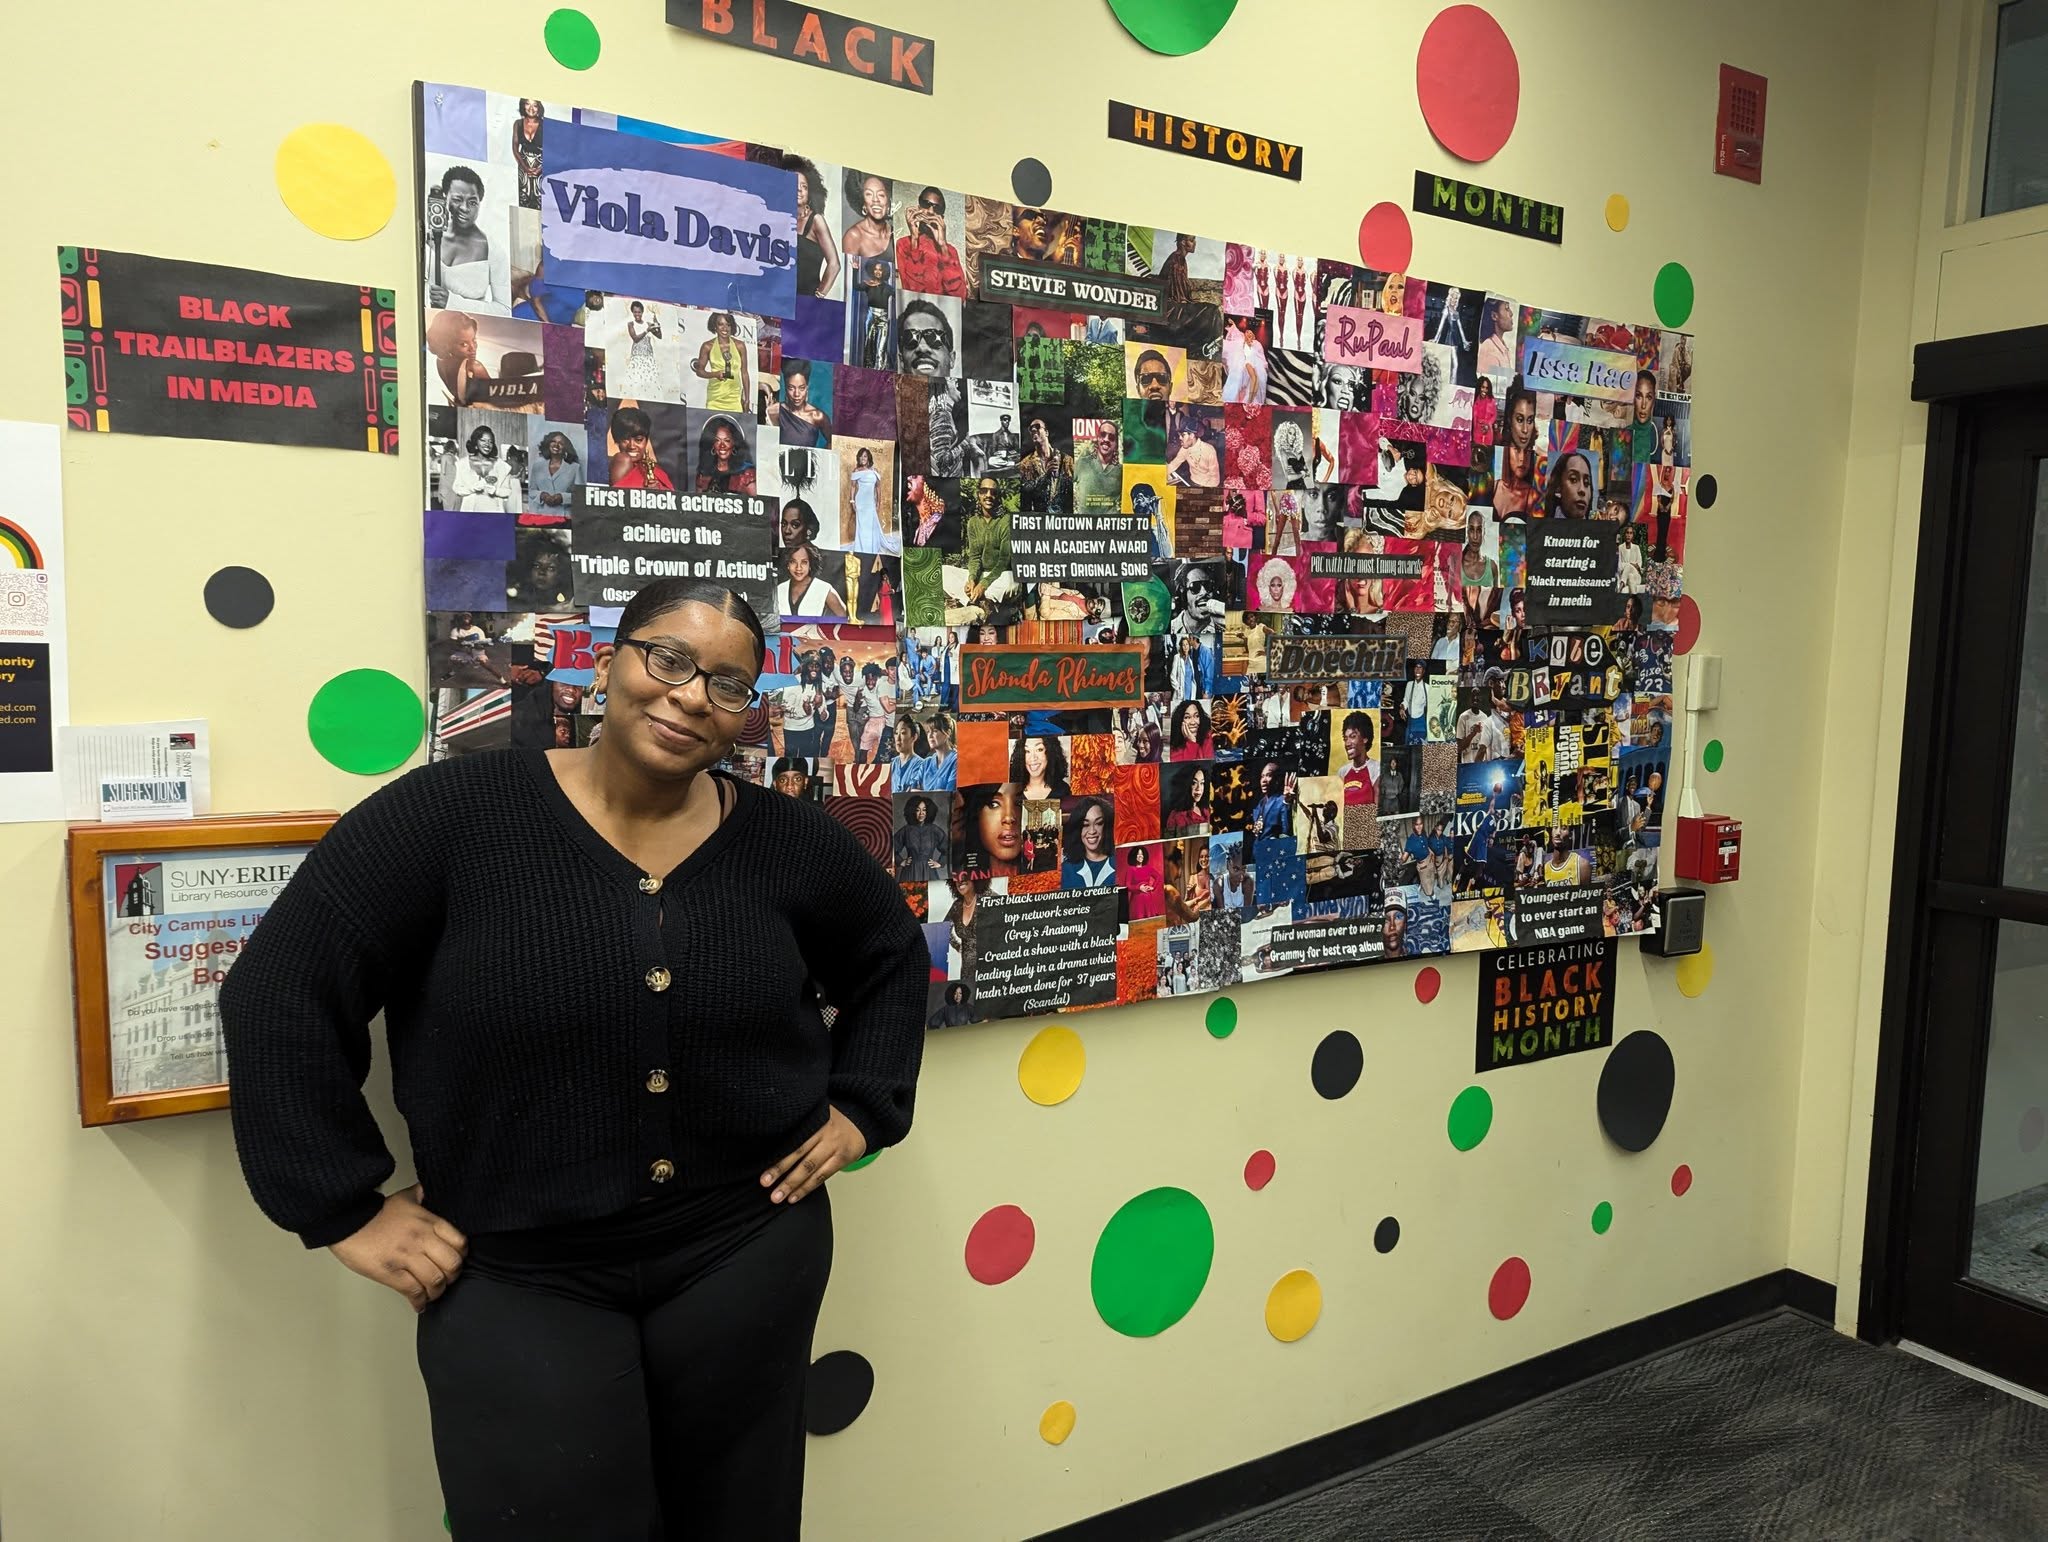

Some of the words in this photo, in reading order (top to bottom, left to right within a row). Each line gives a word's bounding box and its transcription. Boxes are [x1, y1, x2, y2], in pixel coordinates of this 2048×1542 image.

[702, 0, 924, 87] BLACK
[1134, 108, 1297, 173] HISTORY
[1719, 134, 1727, 166] FIRE
[1432, 175, 1559, 236] MONTH
[546, 177, 669, 243] Viola
[674, 206, 791, 267] Davis
[990, 269, 1066, 296] STEVIE
[1072, 282, 1158, 311] WONDER
[178, 296, 292, 328] BLACK
[1334, 314, 1414, 362] RuPaul
[114, 331, 356, 373] TRAILBLAZERS
[1526, 351, 1583, 383] Issa
[1586, 360, 1633, 390] Rae
[167, 376, 204, 400] IN
[210, 379, 317, 409] MEDIA
[489, 382, 538, 398] VIOLA
[585, 486, 625, 508] First
[629, 489, 677, 511] Black
[681, 494, 743, 515] actress
[748, 498, 765, 516] to
[622, 523, 690, 544] achieve
[695, 526, 722, 546] the
[1544, 535, 1581, 548] Known
[1583, 536, 1600, 549] for
[571, 553, 630, 577] "Triple
[634, 558, 689, 577] Crown
[694, 559, 711, 578] of
[1311, 555, 1325, 573] POC
[1325, 556, 1342, 573] with
[1343, 556, 1356, 574] the
[1357, 558, 1375, 574] most
[1376, 557, 1397, 576] Emmy
[1545, 557, 1590, 571] starting
[1590, 560, 1596, 569] a
[1548, 595, 1559, 606] in
[1560, 594, 1592, 606] media
[1279, 640, 1398, 675] Doechii
[967, 656, 1053, 698] Shonda
[1056, 656, 1139, 699] Rhimes
[1556, 726, 1571, 777] Bryant
[1569, 732, 1581, 769] Kobe
[109, 781, 180, 802] SUGGESTIONS
[171, 891, 211, 902] Library
[214, 887, 268, 899] Resource
[1006, 893, 1033, 905] black
[1034, 892, 1070, 902] woman
[1071, 889, 1082, 899] to
[1084, 886, 1112, 897] create
[1519, 890, 1569, 904] Youngest
[1570, 887, 1603, 901] player
[129, 922, 161, 936] City
[168, 917, 236, 932] Campus
[1004, 913, 1020, 926] top
[1021, 905, 1062, 921] network
[1063, 905, 1091, 916] series
[1521, 912, 1533, 923] to
[1534, 909, 1557, 921] ever
[1558, 907, 1583, 918] start
[1585, 905, 1598, 915] an
[1041, 920, 1088, 937] Anatomy)
[1273, 928, 1295, 942] Third
[1296, 928, 1326, 940] woman
[1328, 926, 1348, 937] ever
[1349, 925, 1358, 935] to
[1359, 923, 1375, 934] win
[1376, 924, 1383, 933] a
[1534, 928, 1556, 939] NBA
[1558, 924, 1585, 939] game
[145, 936, 248, 962] Suggest
[1023, 949, 1030, 957] a
[1031, 943, 1059, 957] show
[1060, 939, 1081, 952] with
[1082, 941, 1089, 949] a
[1090, 934, 1115, 948] black
[1270, 949, 1305, 962] Grammy
[1307, 946, 1321, 959] for
[1322, 944, 1342, 957] best
[1342, 945, 1358, 957] rap
[1359, 941, 1385, 953] album
[1496, 941, 1605, 971] CELEBRATING
[193, 967, 226, 985] Bo
[975, 965, 1012, 982] leading
[1013, 962, 1035, 979] lady
[1036, 961, 1047, 972] in
[1047, 963, 1055, 972] a
[1057, 958, 1088, 971] drama
[1089, 951, 1117, 965] which
[1008, 983, 1033, 995] been
[1034, 979, 1057, 992] done
[1056, 975, 1073, 992] for
[1077, 973, 1089, 985] 37
[1089, 972, 1116, 988] years
[1494, 961, 1603, 1007] BLACK
[1023, 992, 1071, 1012] (Scandal)
[1493, 993, 1602, 1032] HISTORY
[156, 1035, 176, 1043] Drop
[1492, 1017, 1601, 1063] MONTH
